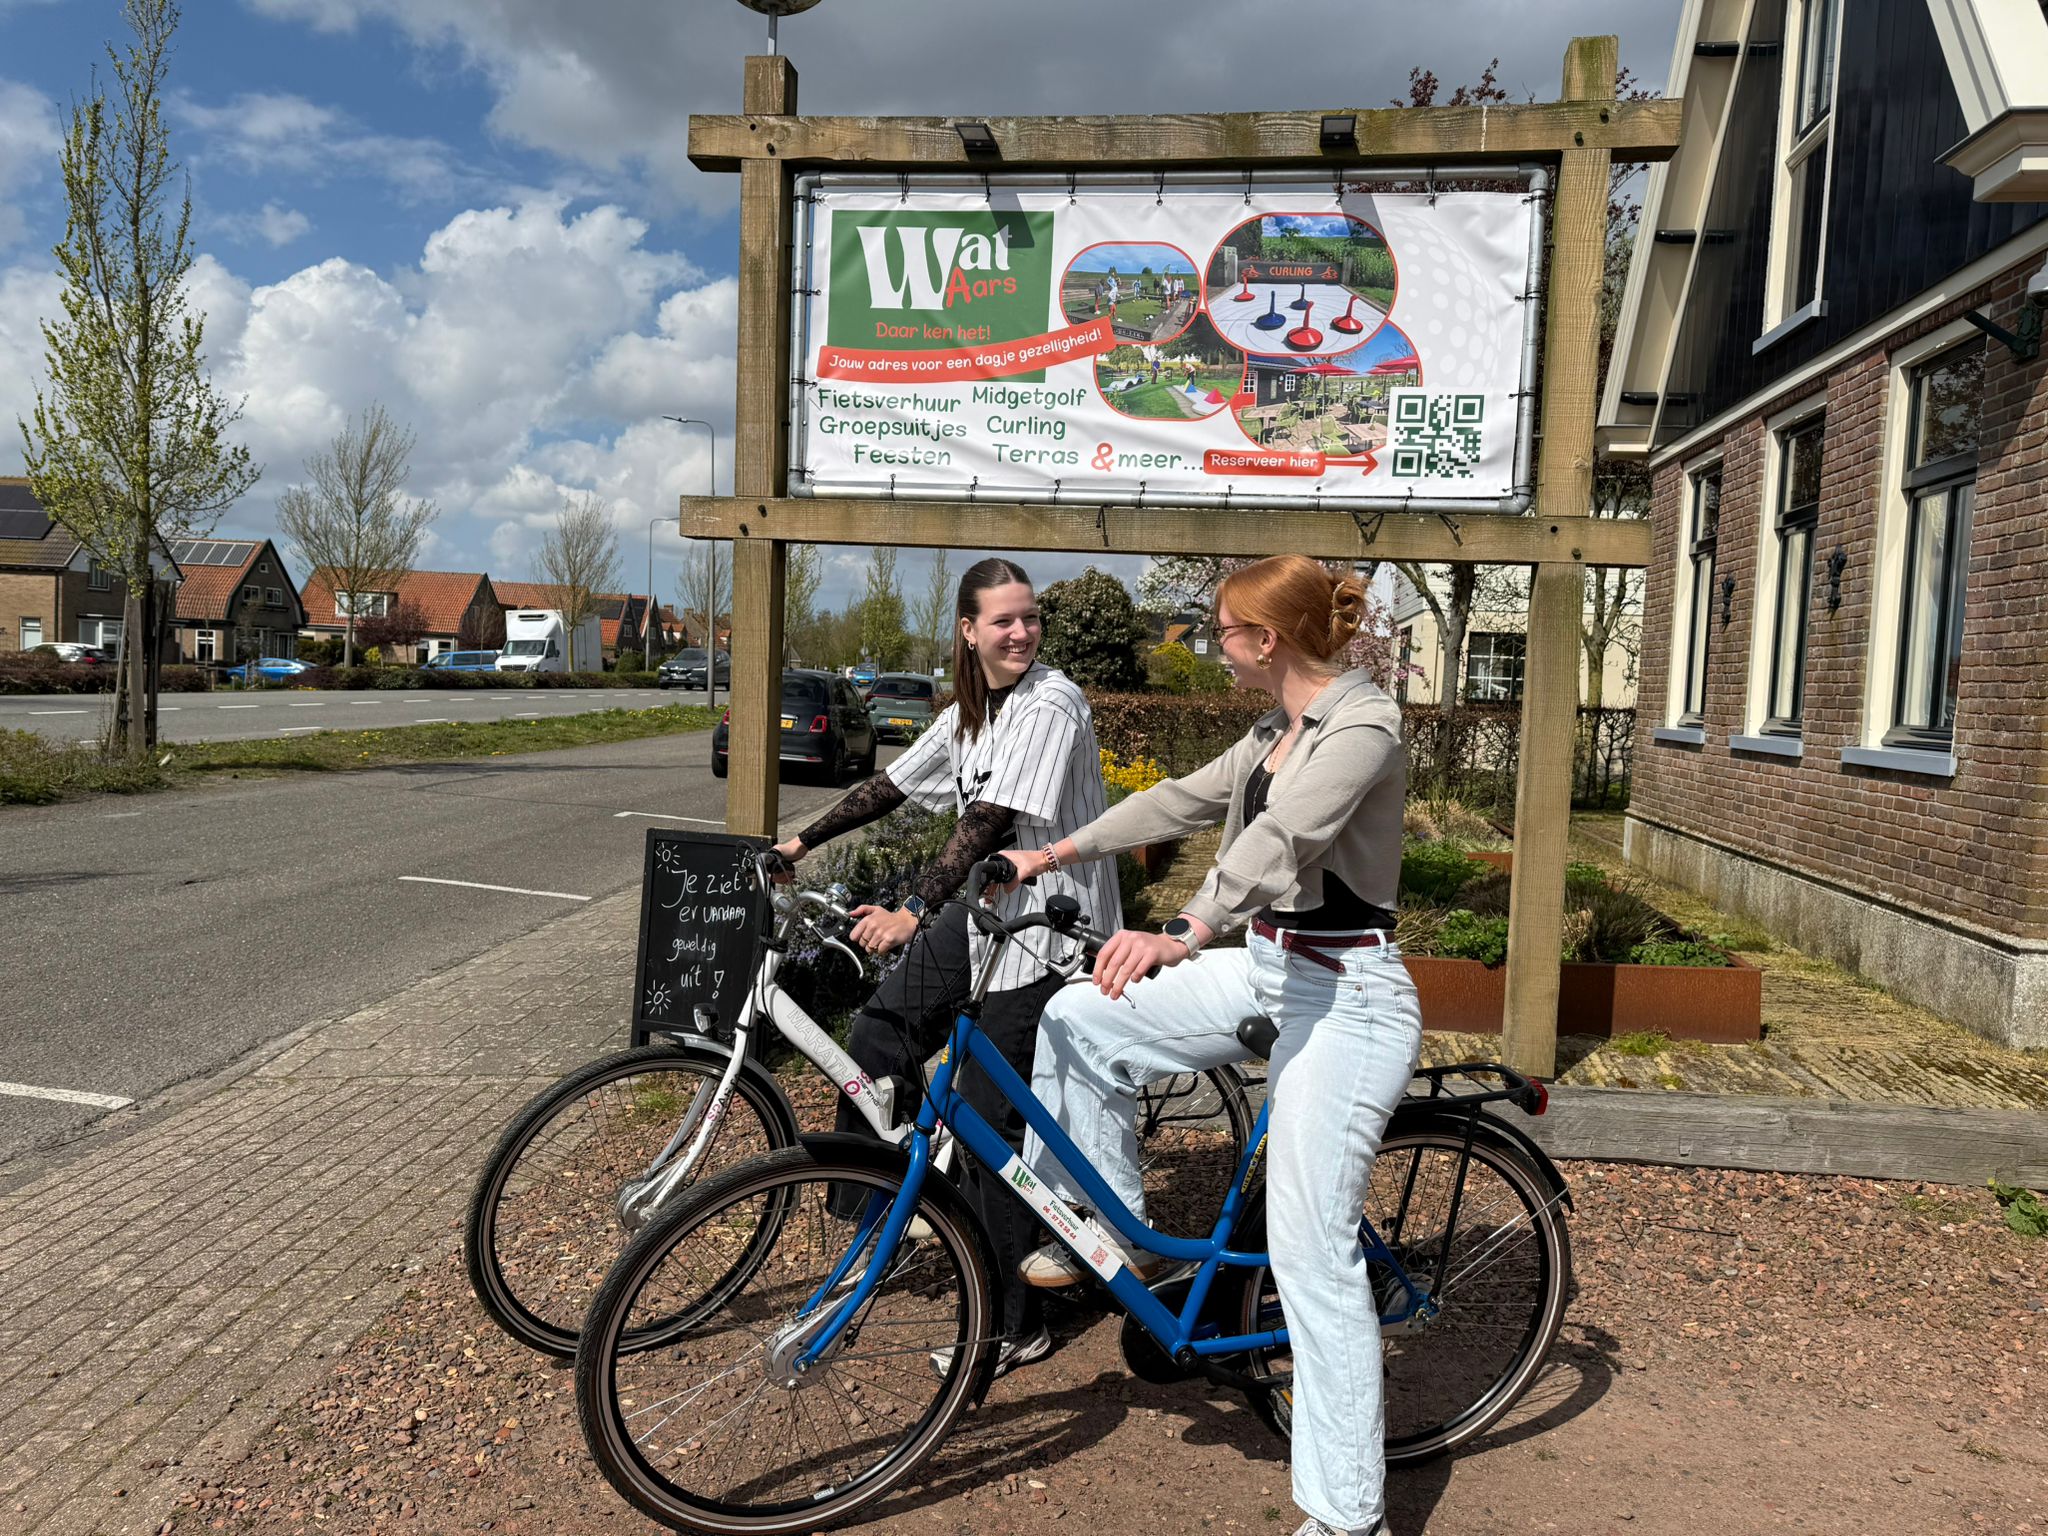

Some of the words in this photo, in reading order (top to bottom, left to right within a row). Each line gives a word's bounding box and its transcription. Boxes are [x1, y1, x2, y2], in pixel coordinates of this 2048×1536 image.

[856, 224, 1013, 310] Wat
[1269, 266, 1313, 277] CURLING
[945, 266, 1017, 308] Aars
[875, 321, 918, 339] Daar
[923, 322, 953, 340] ken
[957, 324, 991, 341] het!
[829, 355, 865, 370] Jouw
[867, 356, 908, 371] adres
[911, 358, 942, 371] voor
[946, 357, 971, 369] een
[974, 351, 1015, 371] dagje
[1018, 327, 1103, 364] gezelligheid!
[817, 388, 961, 413] Fietsverhuur
[972, 385, 1087, 410] Midgetgolf
[818, 416, 967, 441] Groepsuitjes
[986, 416, 1066, 440] Curling
[854, 444, 951, 465] Feesten
[992, 443, 1079, 465] Terras
[1211, 453, 1286, 468] Reserveer
[1289, 454, 1318, 468] hier
[661, 869, 698, 908] Je
[679, 905, 698, 923] er
[666, 933, 716, 961] geweldig
[680, 965, 702, 988] uit
[787, 1006, 872, 1107] MARATHON
[1011, 1165, 1037, 1190] Wat
[1049, 1200, 1079, 1231] Fietsverhuur
